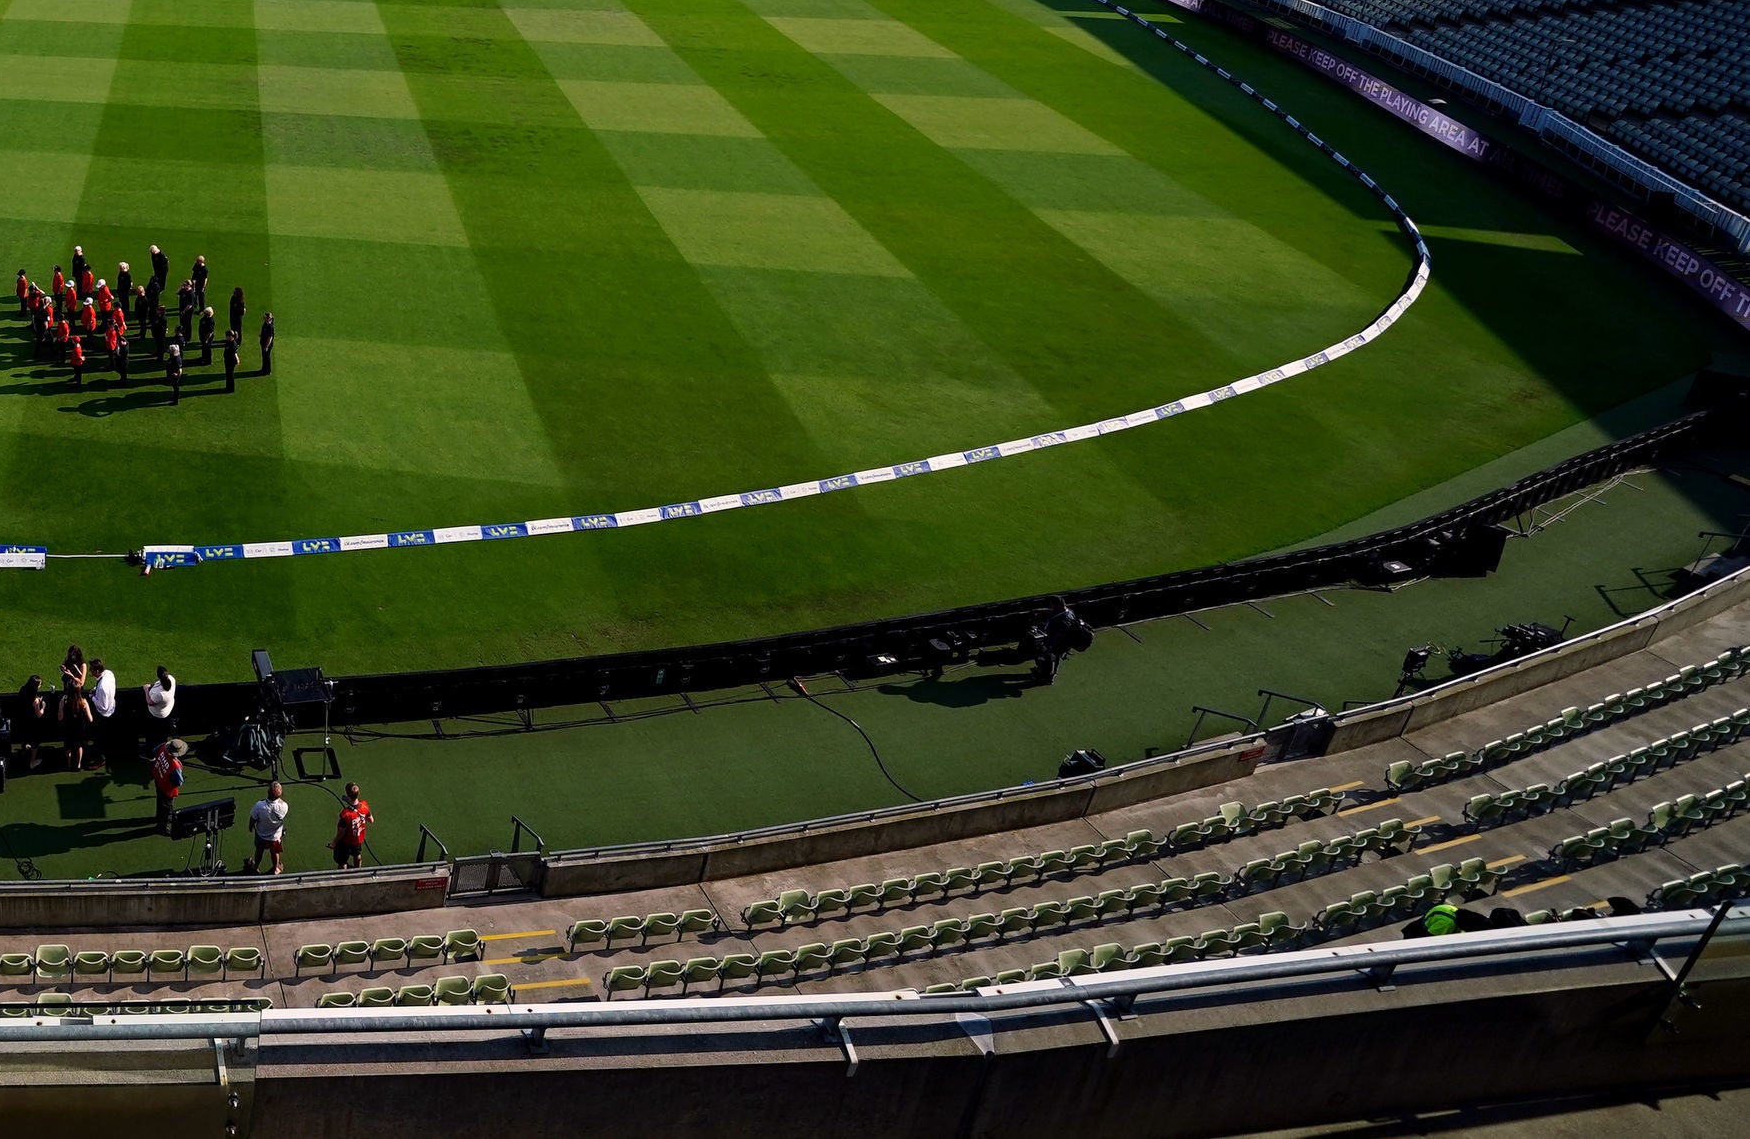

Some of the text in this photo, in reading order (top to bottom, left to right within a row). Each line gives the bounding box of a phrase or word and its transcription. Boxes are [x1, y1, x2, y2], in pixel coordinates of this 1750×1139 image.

[1266, 30, 1489, 157] PLEASE KEEP OFF THE PLAYING AREA AT
[1587, 202, 1736, 301] PLEASE KEEP OFF
